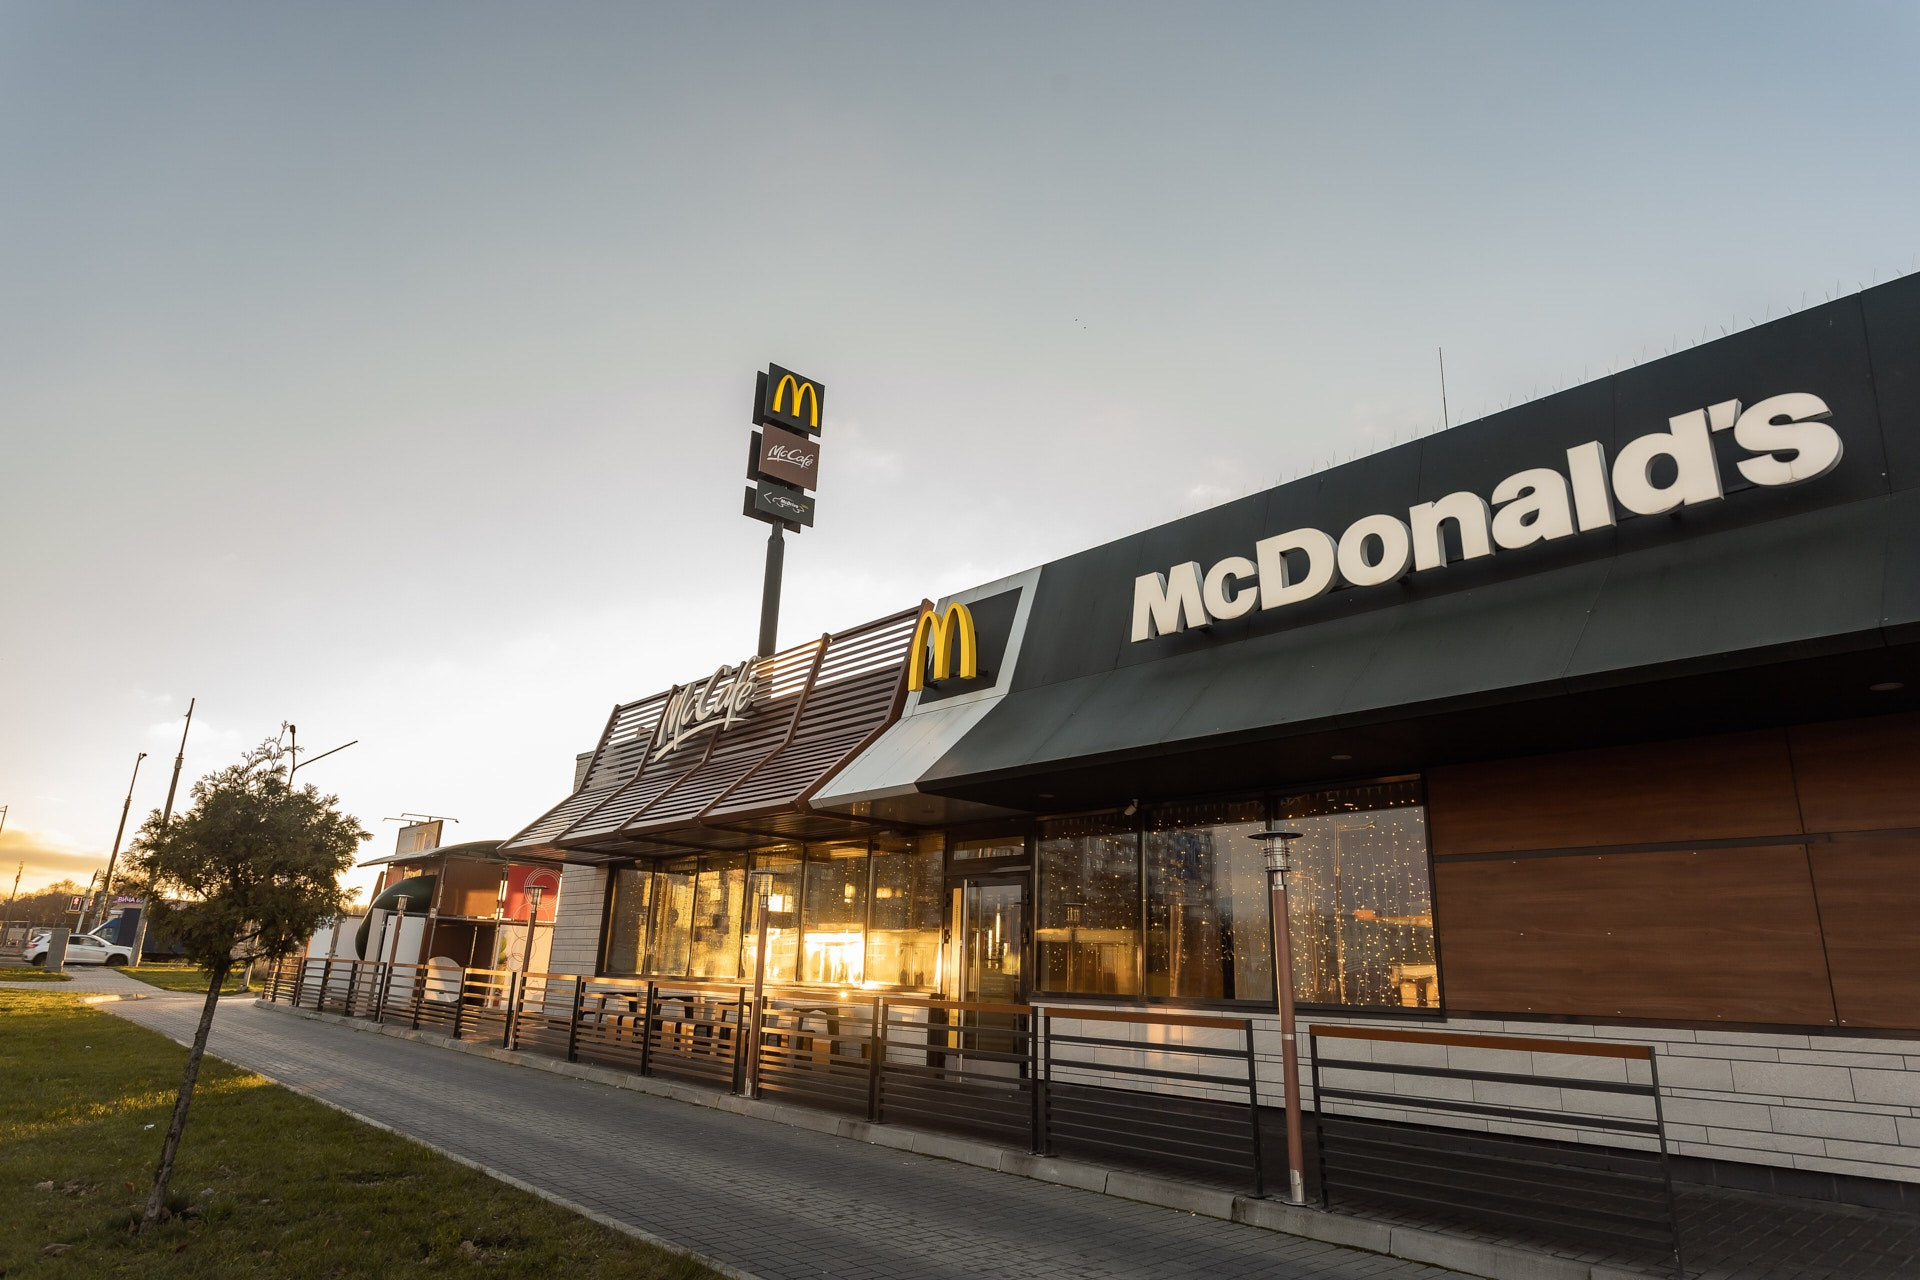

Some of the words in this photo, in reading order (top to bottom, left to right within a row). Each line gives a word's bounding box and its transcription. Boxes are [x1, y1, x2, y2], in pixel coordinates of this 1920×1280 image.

[767, 444, 814, 470] McCafé
[1131, 392, 1844, 643] McDonald's
[655, 655, 762, 752] McCafé
